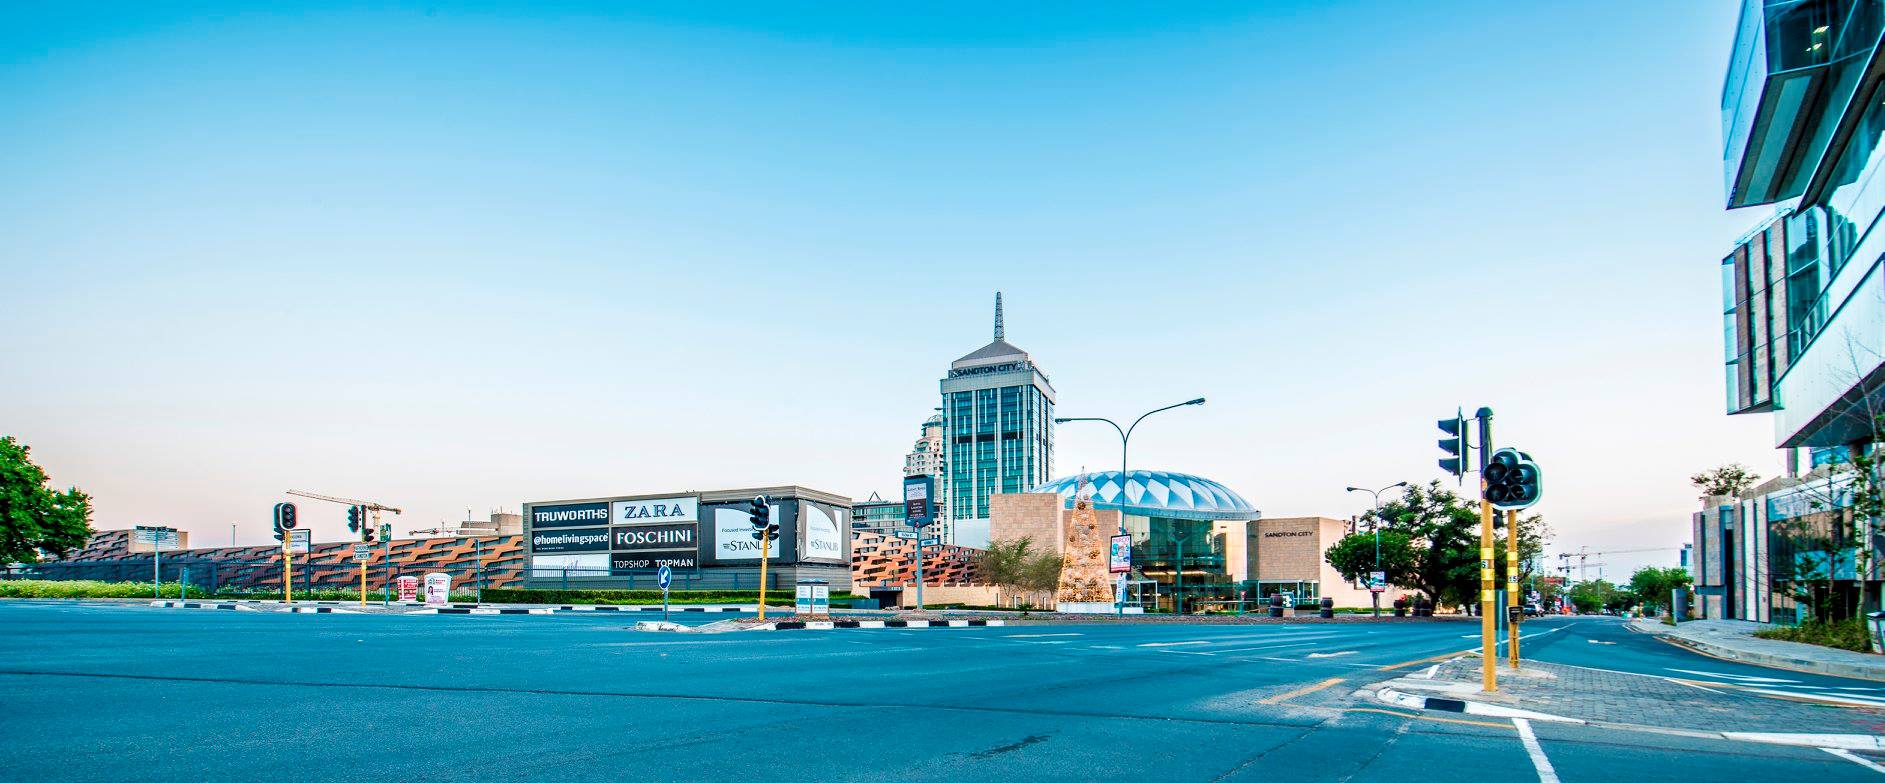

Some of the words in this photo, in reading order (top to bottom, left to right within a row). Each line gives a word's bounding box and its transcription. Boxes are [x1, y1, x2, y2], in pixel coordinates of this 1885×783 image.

[957, 366, 996, 375] SANDTON
[998, 363, 1018, 371] CITY
[535, 509, 608, 522] TRUWORTHS
[624, 503, 685, 519] ZARA
[616, 530, 691, 545] FOSCHINI
[730, 540, 772, 551] STANLB
[614, 560, 649, 569] TOPSHOP
[655, 558, 694, 567] TOPMAN
